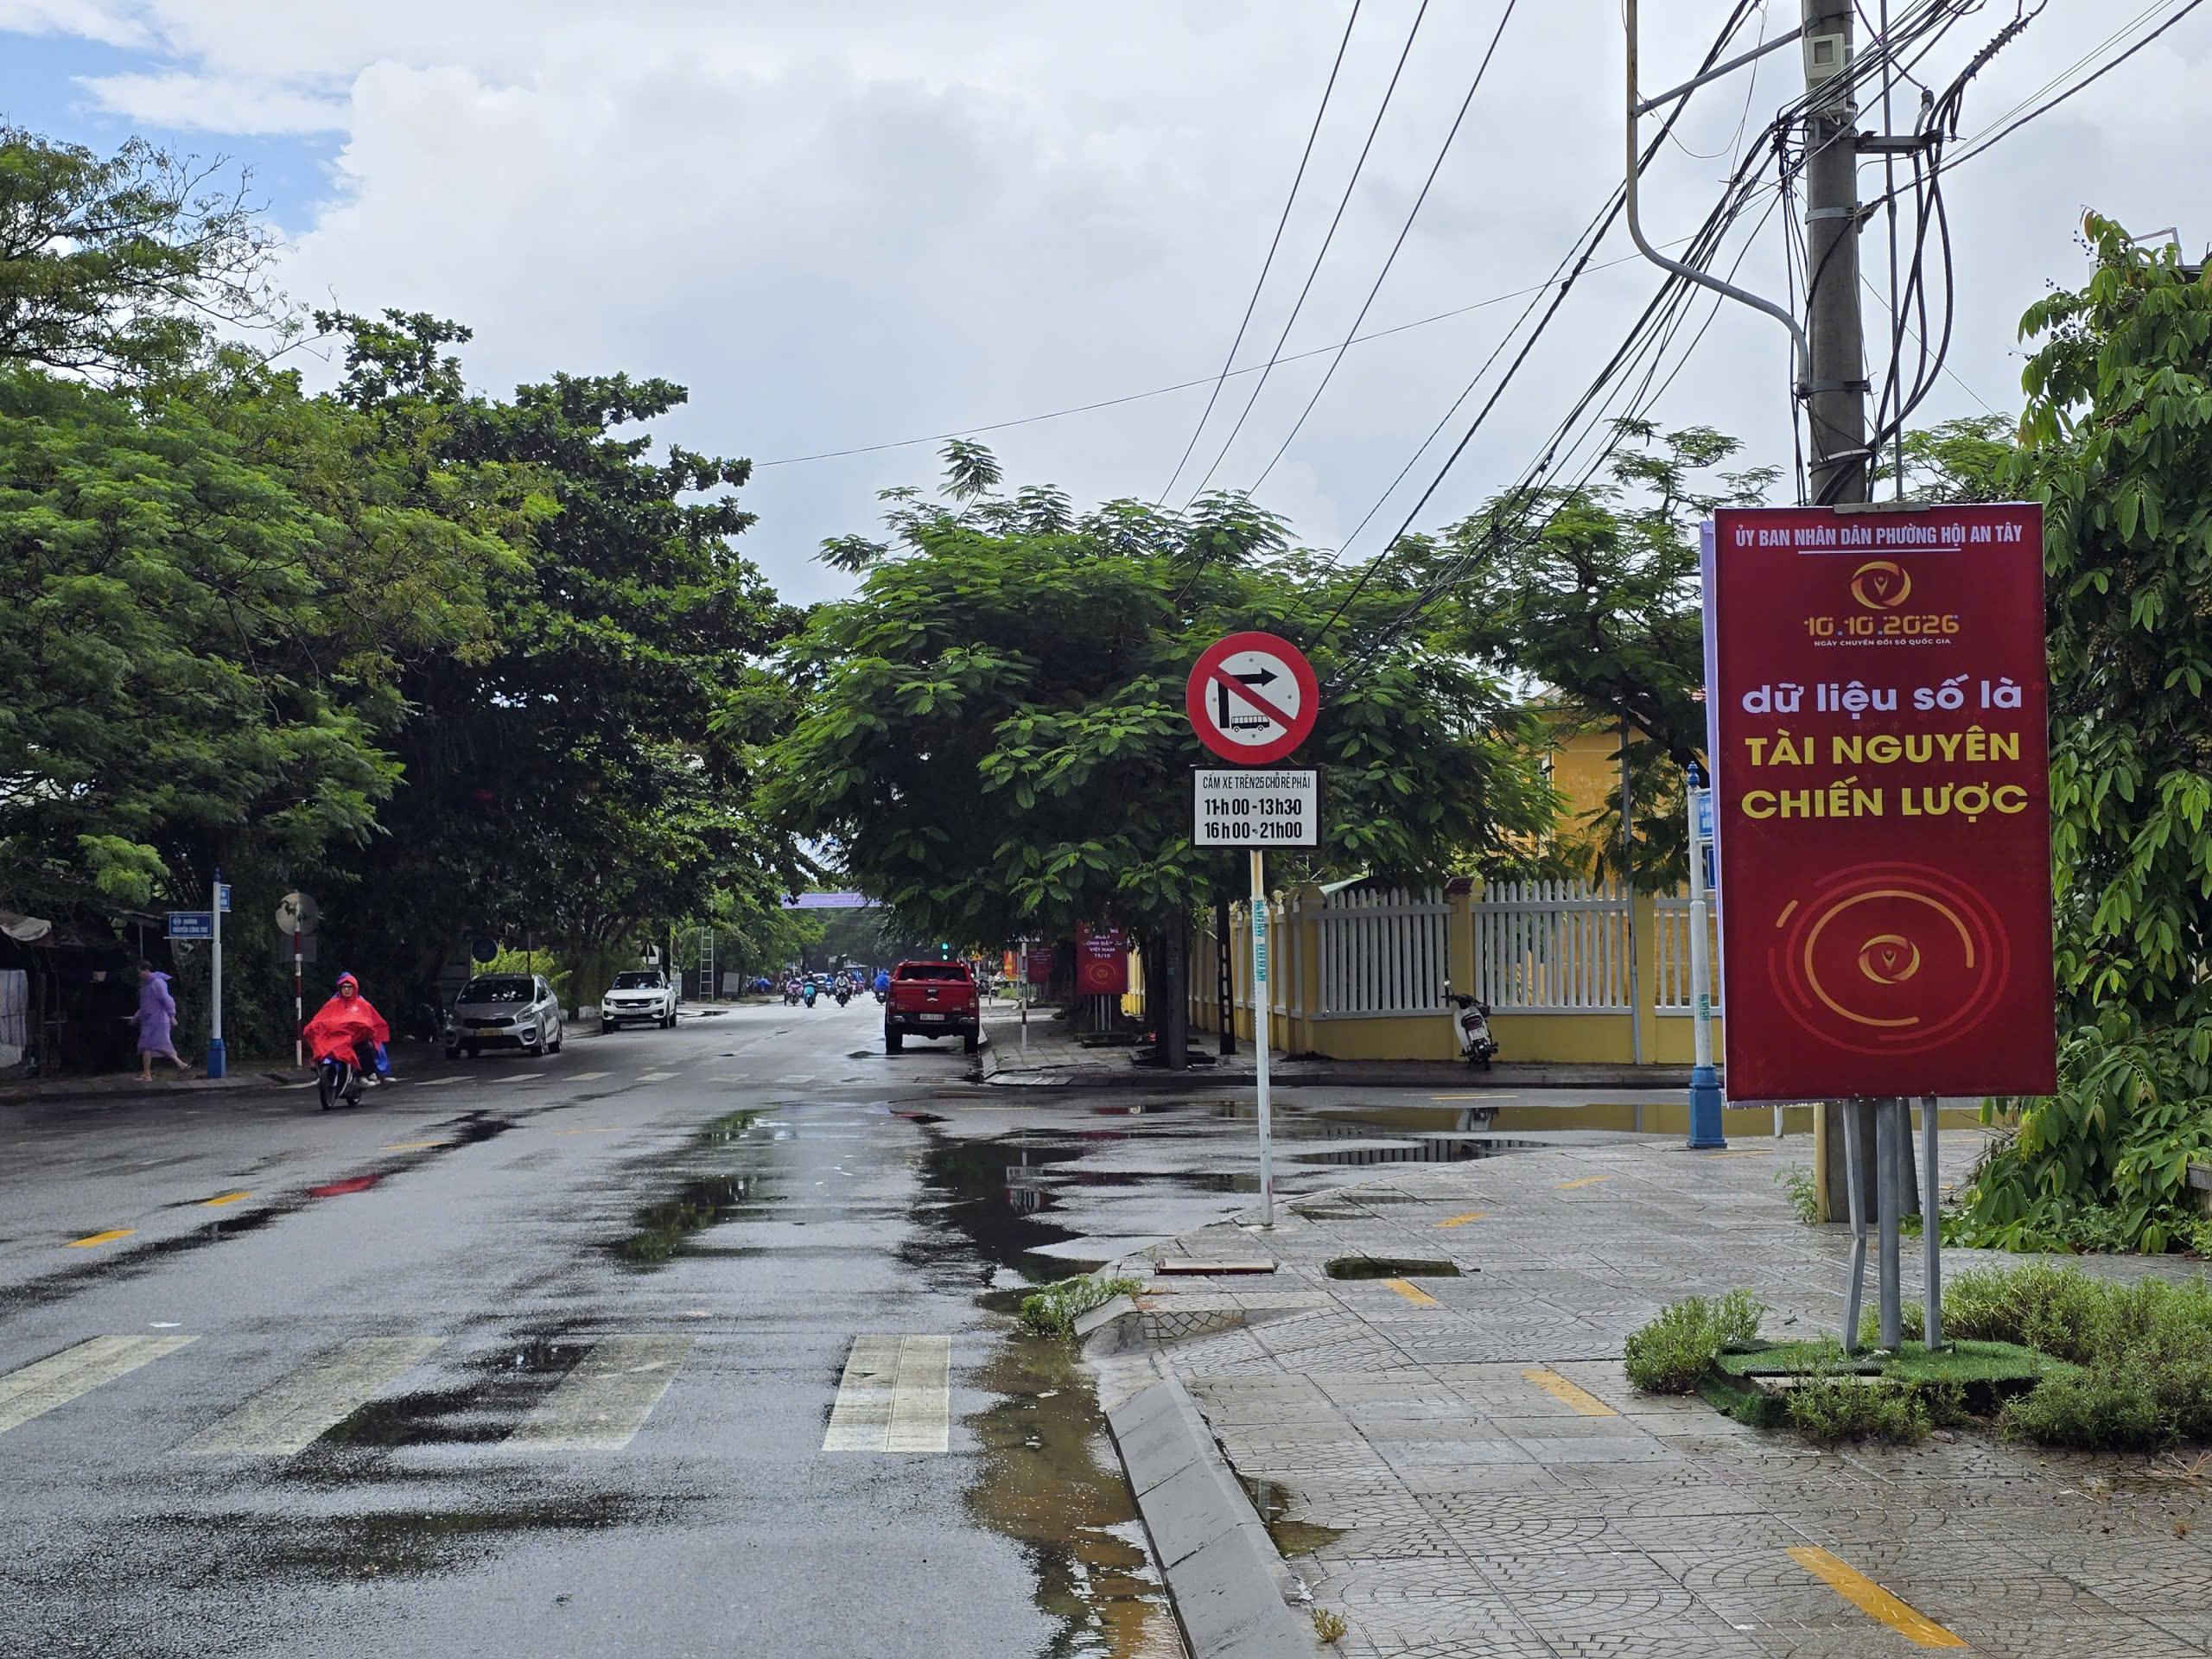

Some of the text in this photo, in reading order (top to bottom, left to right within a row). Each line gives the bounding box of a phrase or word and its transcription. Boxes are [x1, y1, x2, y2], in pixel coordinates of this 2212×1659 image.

[1736, 523, 2023, 547] ỦY BAN NHÂN DÂN PHƯỜNG HỘI AN TÂY
[1804, 614, 1959, 636] 10.10.2026
[1742, 674, 2022, 720] dữ liệu số là
[1745, 725, 2020, 766] TÀI NGUYÊN
[1204, 772, 1220, 788] CẤM
[1223, 777, 1233, 789] XE
[1235, 774, 1255, 789] TRÊN
[1255, 777, 1264, 788] 25
[1265, 772, 1281, 788] CHỖ
[1292, 772, 1311, 788] PHẢI
[1742, 776, 1884, 819] CHIẾN
[1902, 781, 2028, 823] LƯỢC
